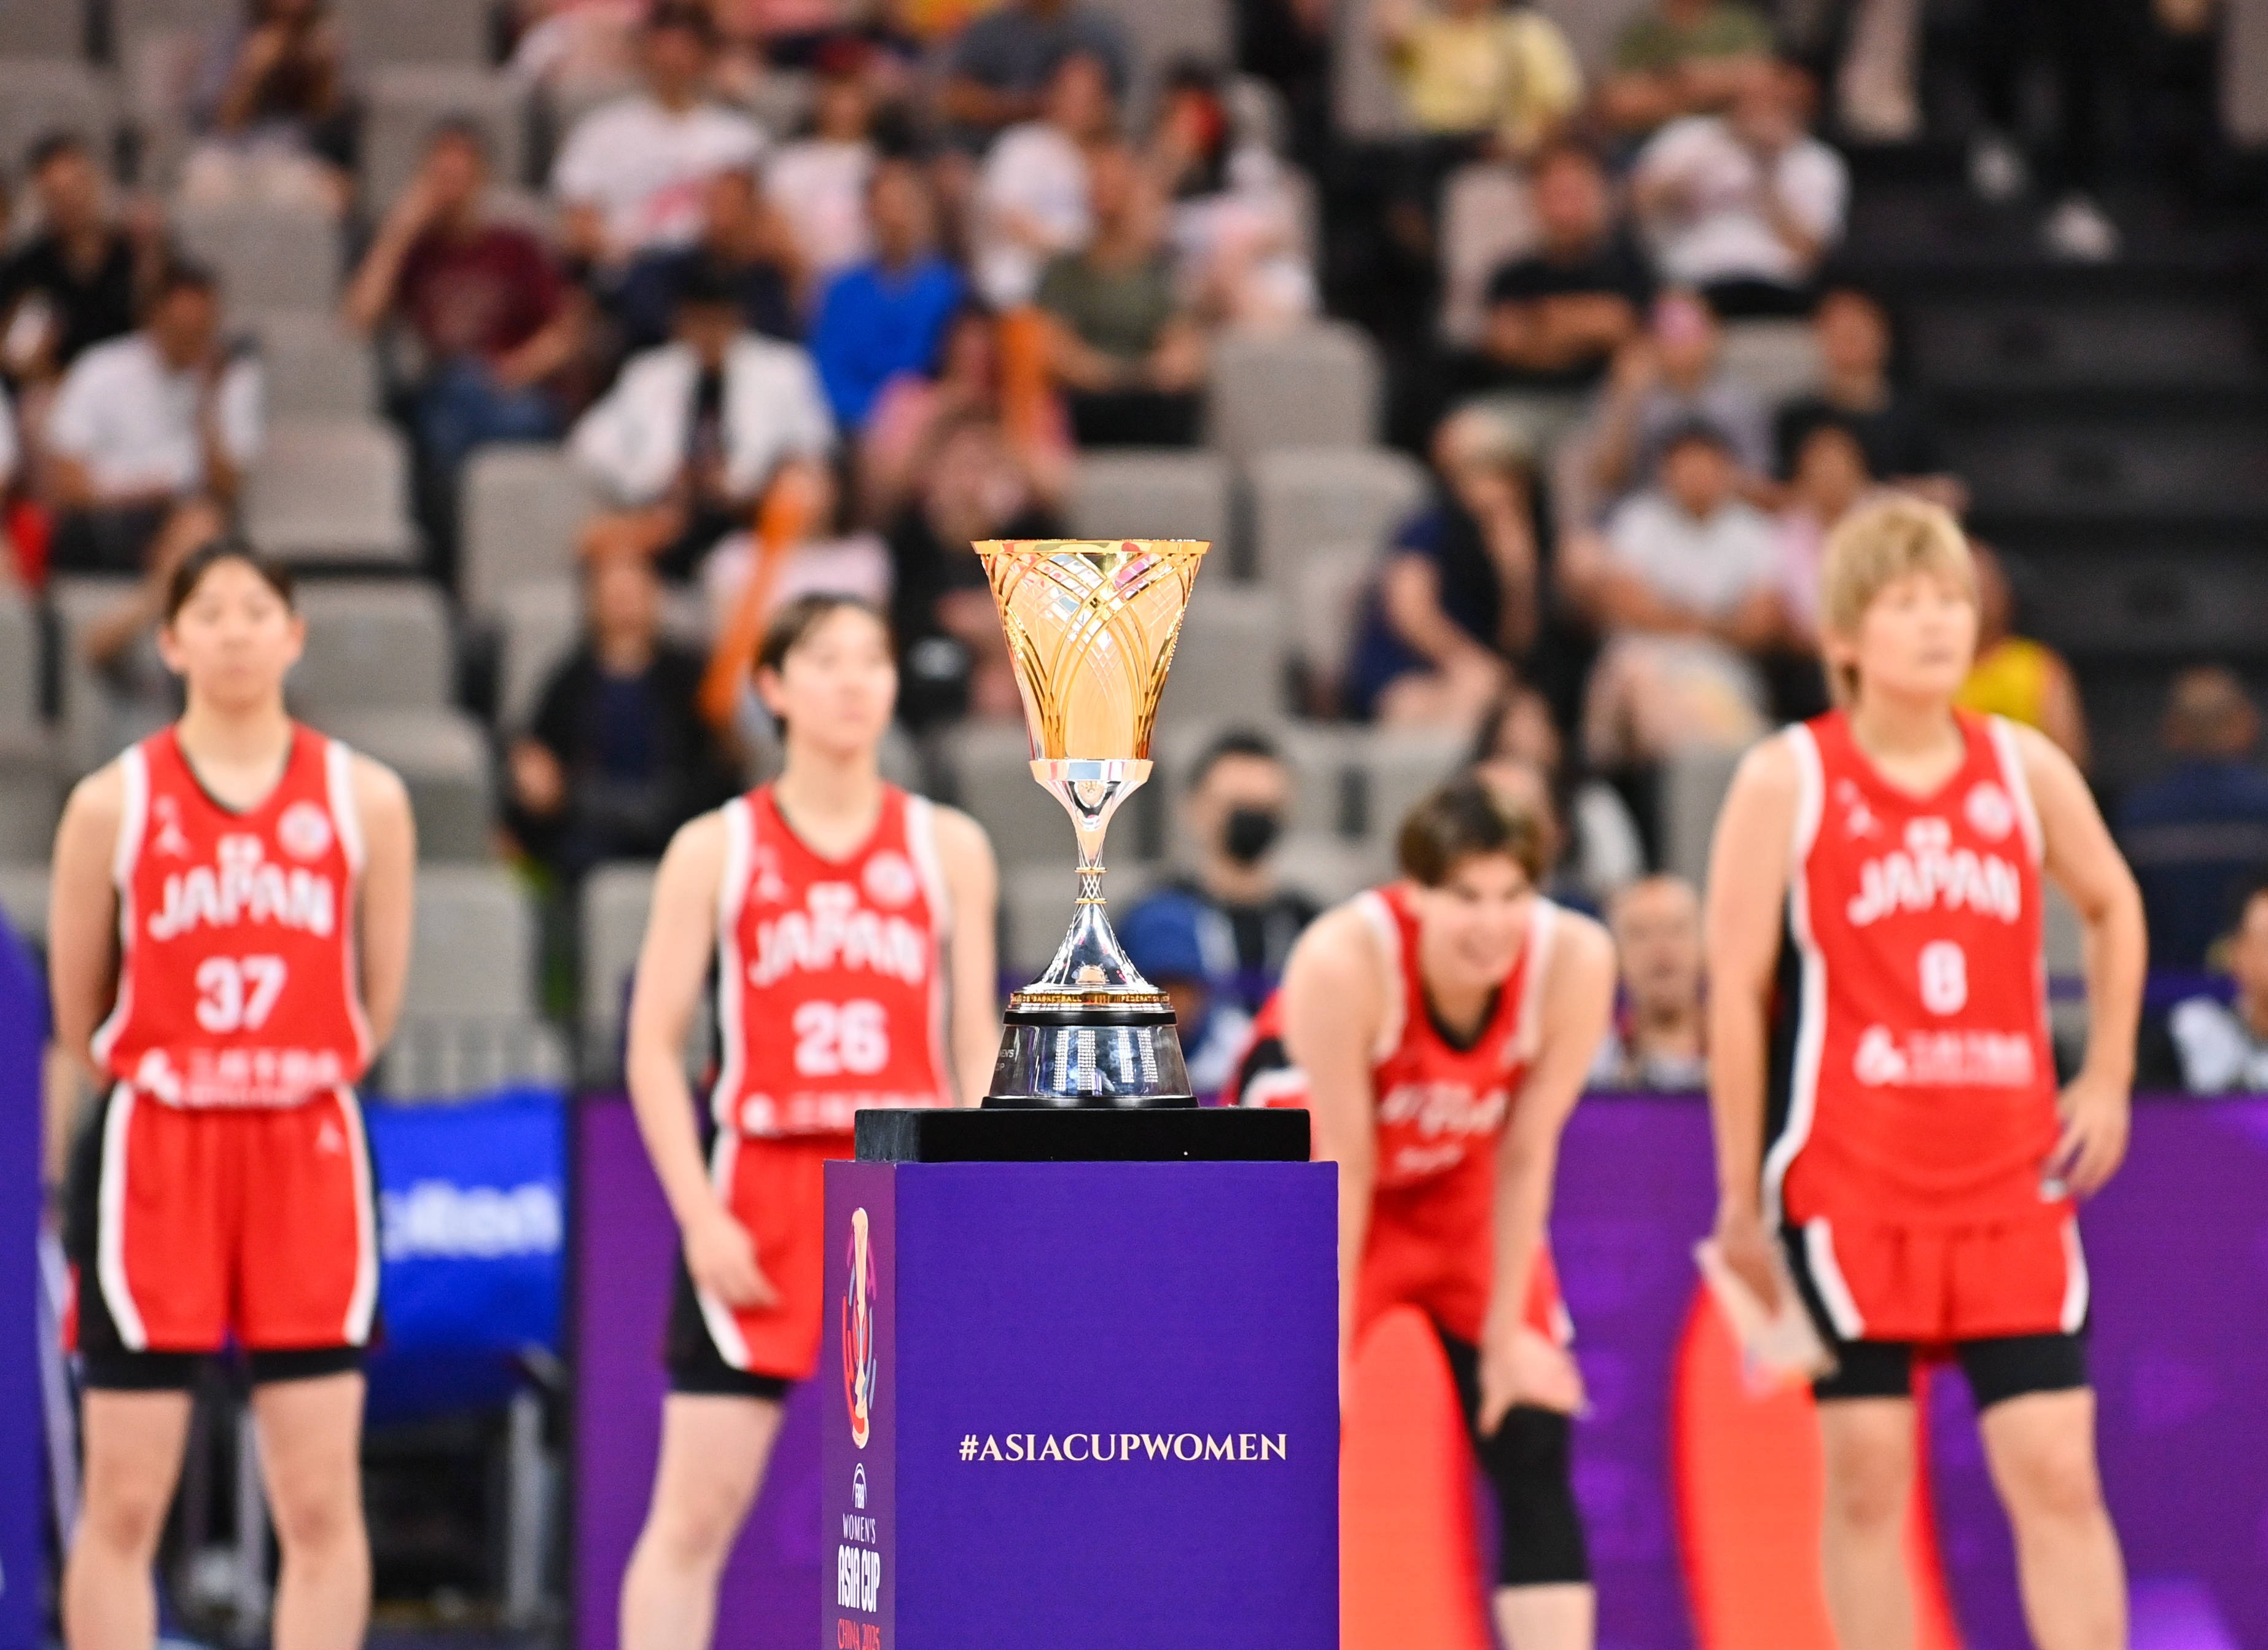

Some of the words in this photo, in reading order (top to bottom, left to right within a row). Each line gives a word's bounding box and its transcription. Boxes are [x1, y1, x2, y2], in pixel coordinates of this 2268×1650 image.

[148, 863, 336, 940] JAPAN
[1845, 848, 2021, 926] JAPAN
[748, 910, 927, 987] JAPAN
[195, 954, 287, 1033] 37
[792, 997, 890, 1078] 26
[959, 1433, 1287, 1461] #ASIACUPWOMEN
[842, 1513, 876, 1544] WOMEN'S
[838, 1544, 860, 1609] ASIA
[861, 1548, 881, 1613] CUP
[837, 1618, 860, 1650] CHINA
[862, 1623, 881, 1650] 2025
